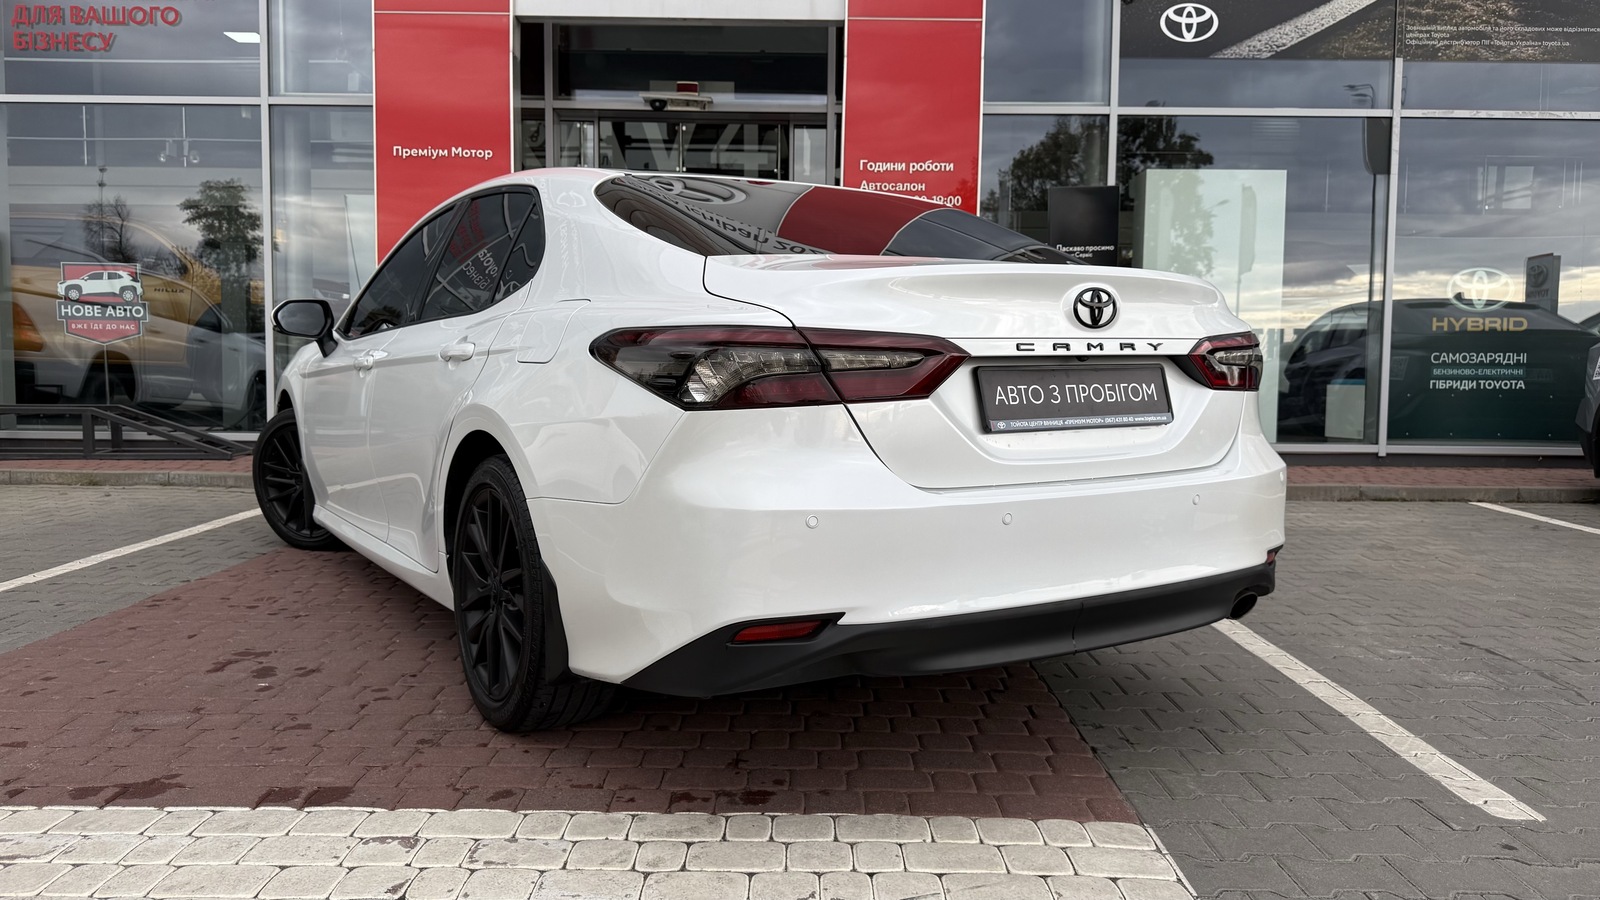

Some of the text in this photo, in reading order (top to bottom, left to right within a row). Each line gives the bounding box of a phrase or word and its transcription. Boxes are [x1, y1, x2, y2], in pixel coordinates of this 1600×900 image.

[11, 5, 182, 27] ДЛЯ ВАШОГО
[13, 32, 114, 51] БІЗНЕСУ
[393, 145, 493, 160] Преміум Мотор
[859, 159, 954, 174] Години роботи
[859, 180, 926, 192] Автосалон
[61, 304, 144, 318] НОВЕ АВТО
[90, 322, 103, 331] ЇДЕ
[1432, 317, 1528, 332] HYBRID
[1015, 342, 1164, 351] CAMRY
[1430, 352, 1527, 366] САМОЗАРЯДНІ
[1432, 367, 1524, 376] БЕНЗИНОВО-ЕЛЕКТРИЧНІ
[1429, 379, 1526, 391] ГІБРИДИ TOYOTA
[995, 382, 1158, 406] АВТО З ПРОБІГОМ
[1010, 420, 1029, 428] ТОЙОТА
